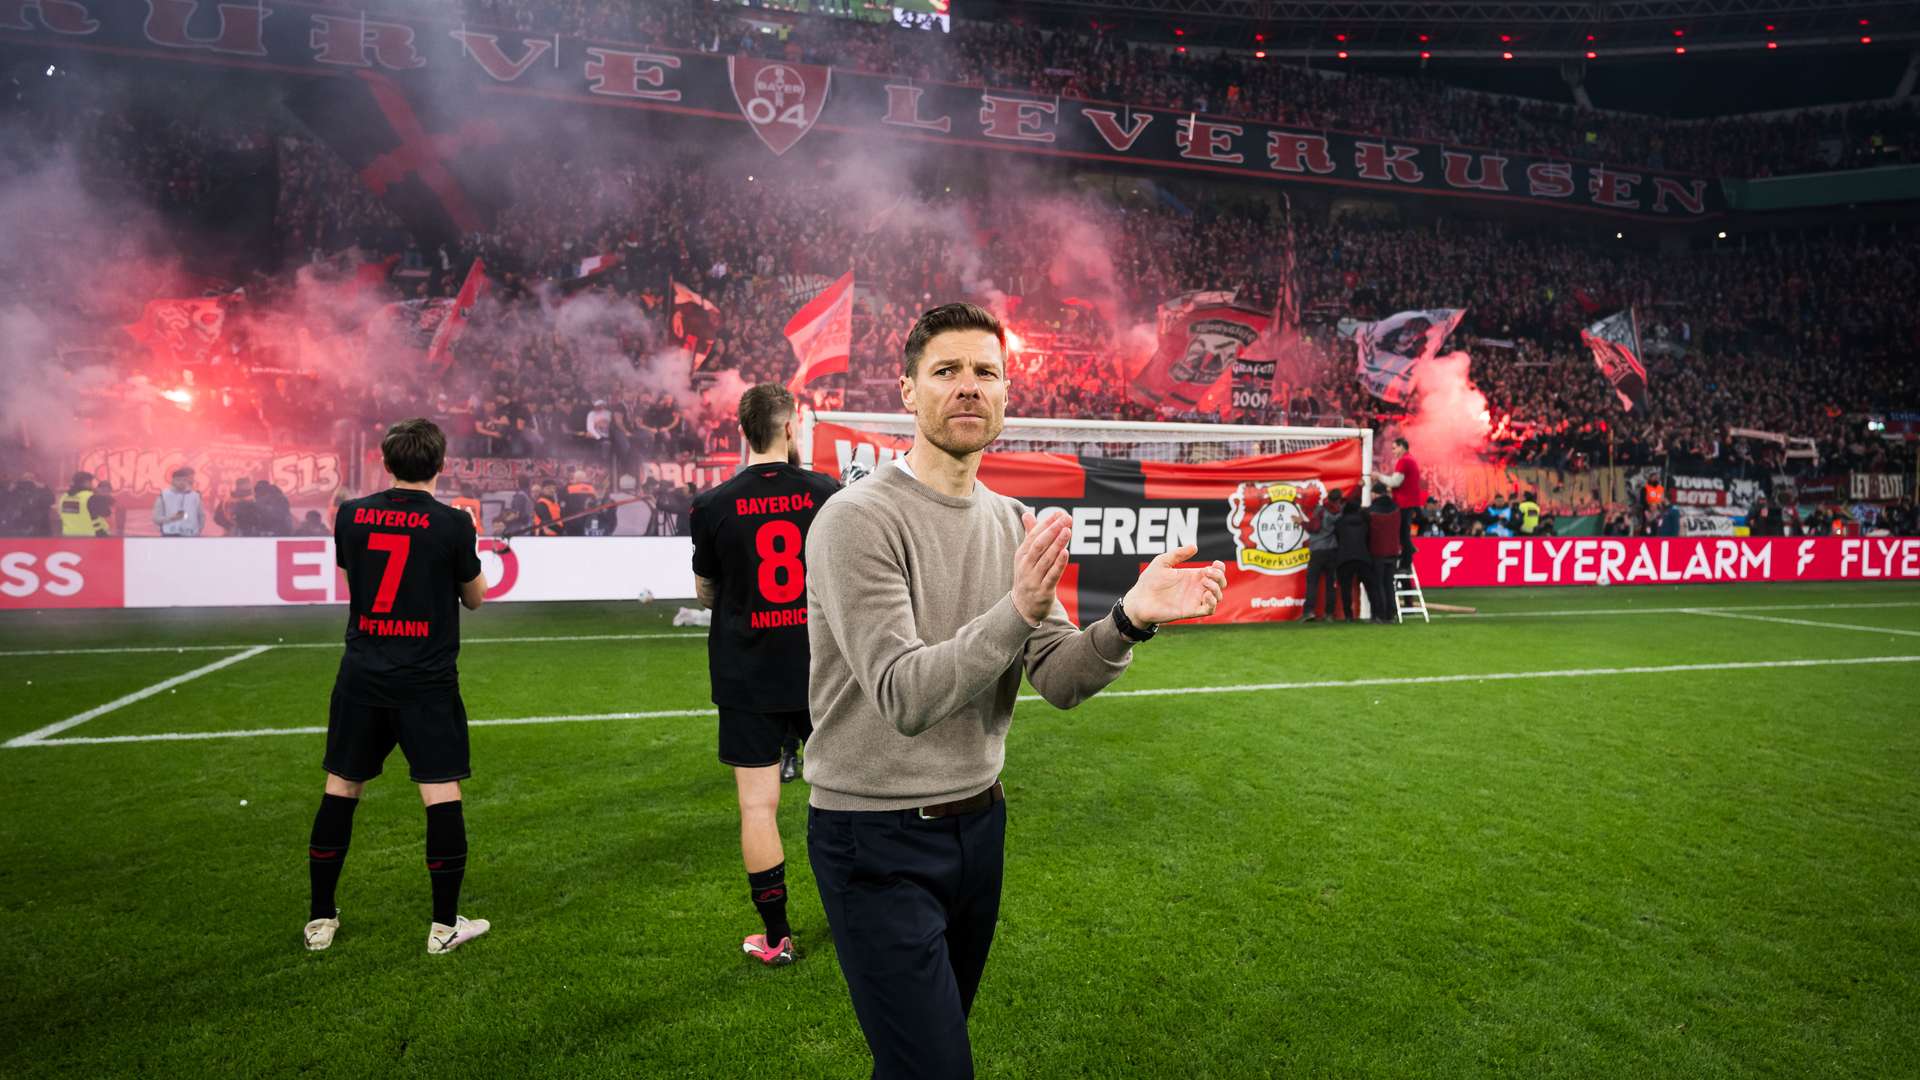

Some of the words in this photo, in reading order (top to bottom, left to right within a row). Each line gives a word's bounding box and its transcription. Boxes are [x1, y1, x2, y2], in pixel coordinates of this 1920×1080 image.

[747, 97, 808, 128] 04
[881, 84, 1706, 213] LEVERKUSEN
[271, 453, 341, 495] 513
[1037, 507, 1199, 555] EREN
[1261, 523, 1300, 532] BAYER
[0, 552, 85, 596] SS
[368, 533, 411, 613] 7
[756, 520, 804, 604] 8
[1497, 539, 1773, 583] FLYERALARM
[1841, 538, 1920, 577] FLYE
